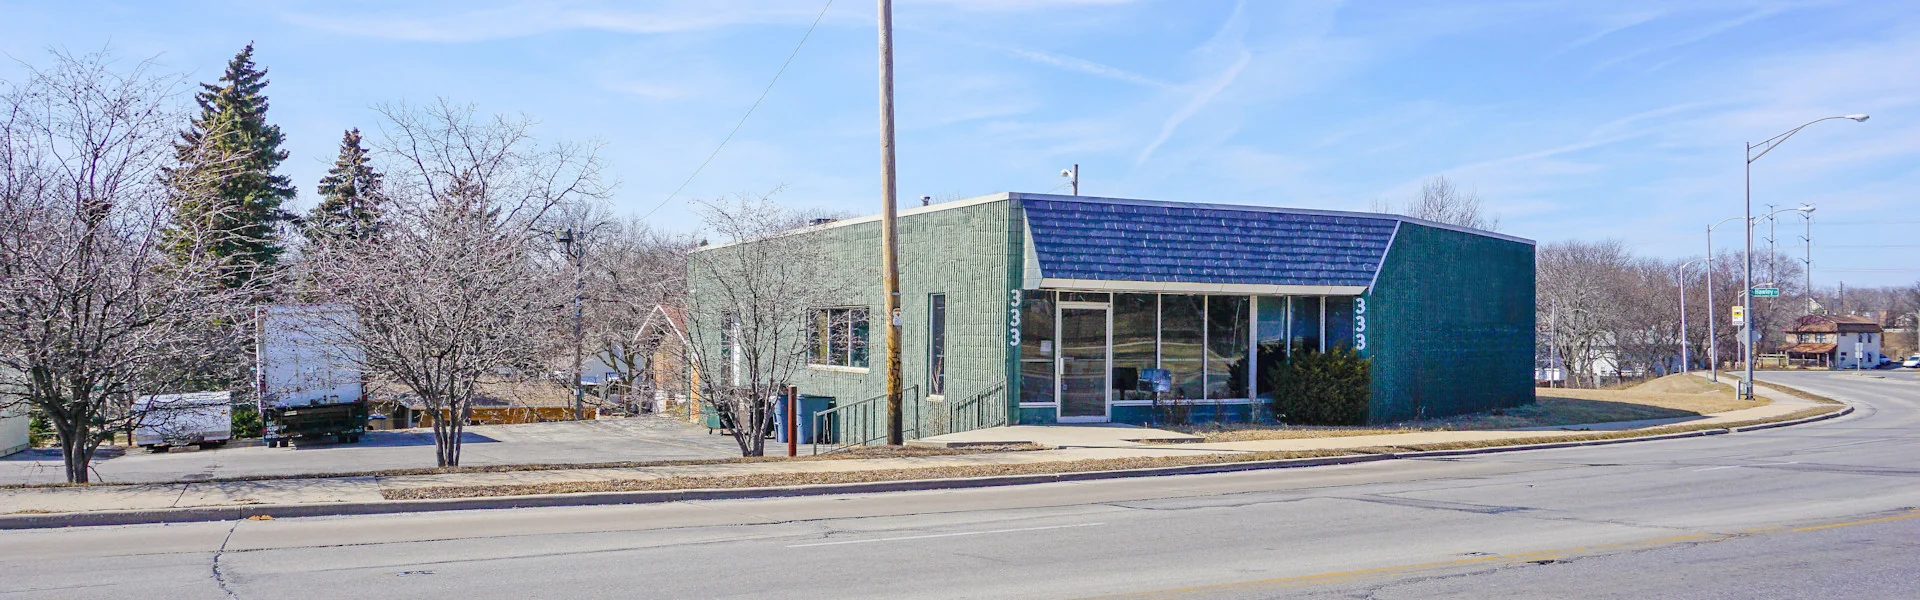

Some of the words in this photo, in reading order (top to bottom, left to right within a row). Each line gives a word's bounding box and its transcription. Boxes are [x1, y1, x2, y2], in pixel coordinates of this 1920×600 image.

[1009, 288, 1021, 347] 333
[1754, 288, 1773, 296] Hawley
[1355, 297, 1366, 351] 333
